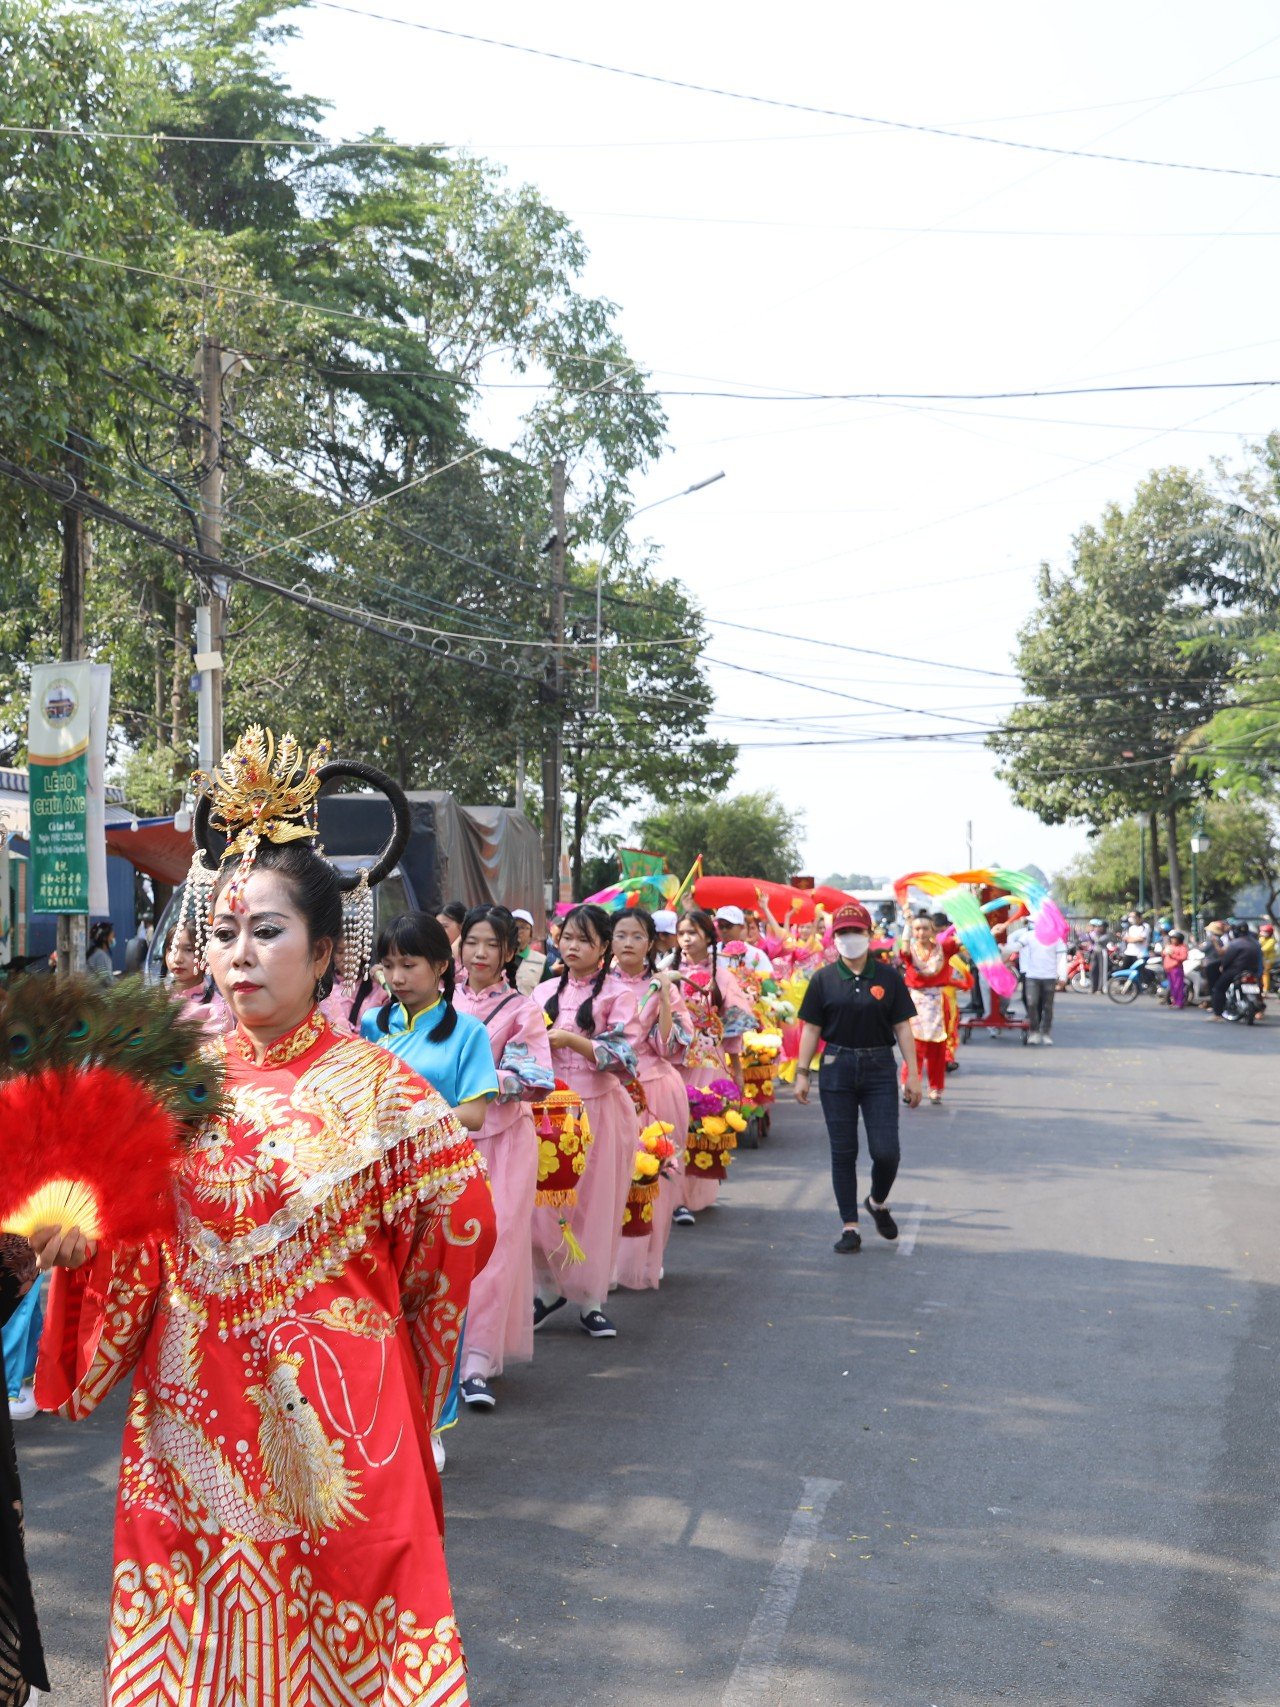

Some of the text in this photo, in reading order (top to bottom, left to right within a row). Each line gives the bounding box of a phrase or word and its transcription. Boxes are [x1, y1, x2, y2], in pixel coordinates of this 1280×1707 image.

[44, 771, 77, 794] LỄ HỘI
[64, 794, 86, 814] ÔNG
